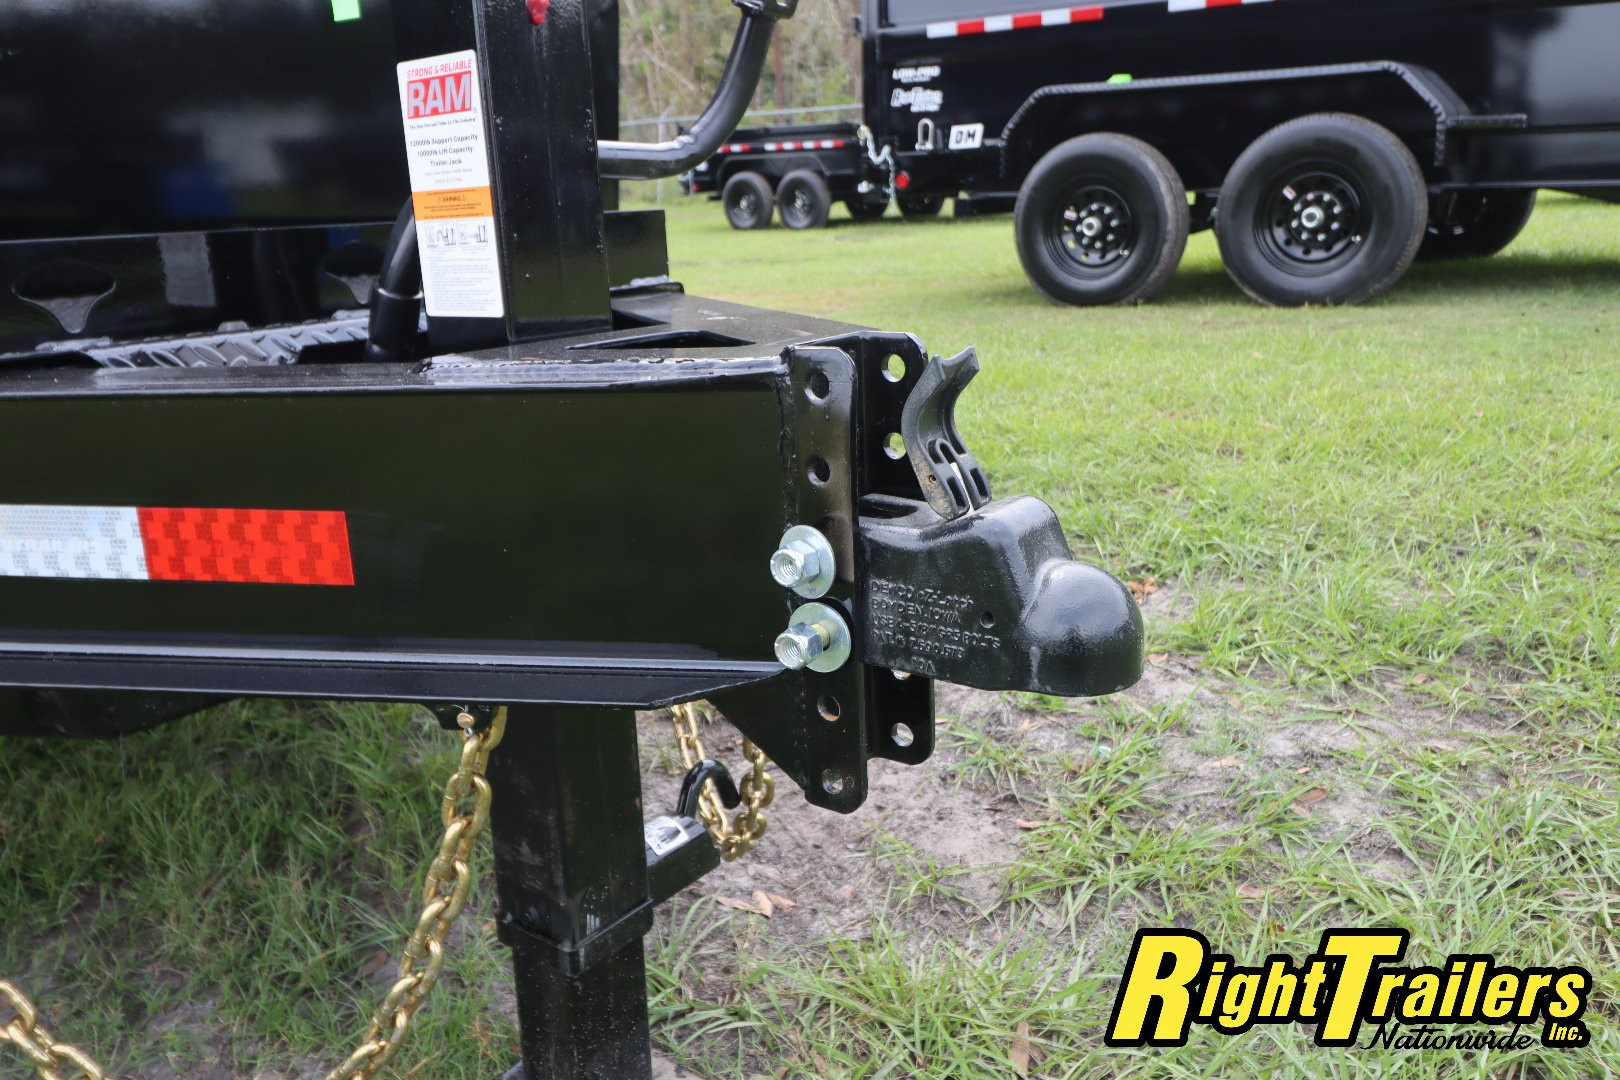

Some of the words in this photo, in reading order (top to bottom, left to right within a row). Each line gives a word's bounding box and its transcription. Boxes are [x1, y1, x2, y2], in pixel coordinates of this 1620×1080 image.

[407, 66, 433, 79] STRONG
[434, 65, 439, 74] &
[440, 59, 472, 73] RELIABLE
[408, 74, 471, 117] RAM
[431, 137, 453, 146] Support
[453, 134, 478, 143] Capacity
[448, 146, 473, 154] Capacity
[449, 158, 462, 166] Jack
